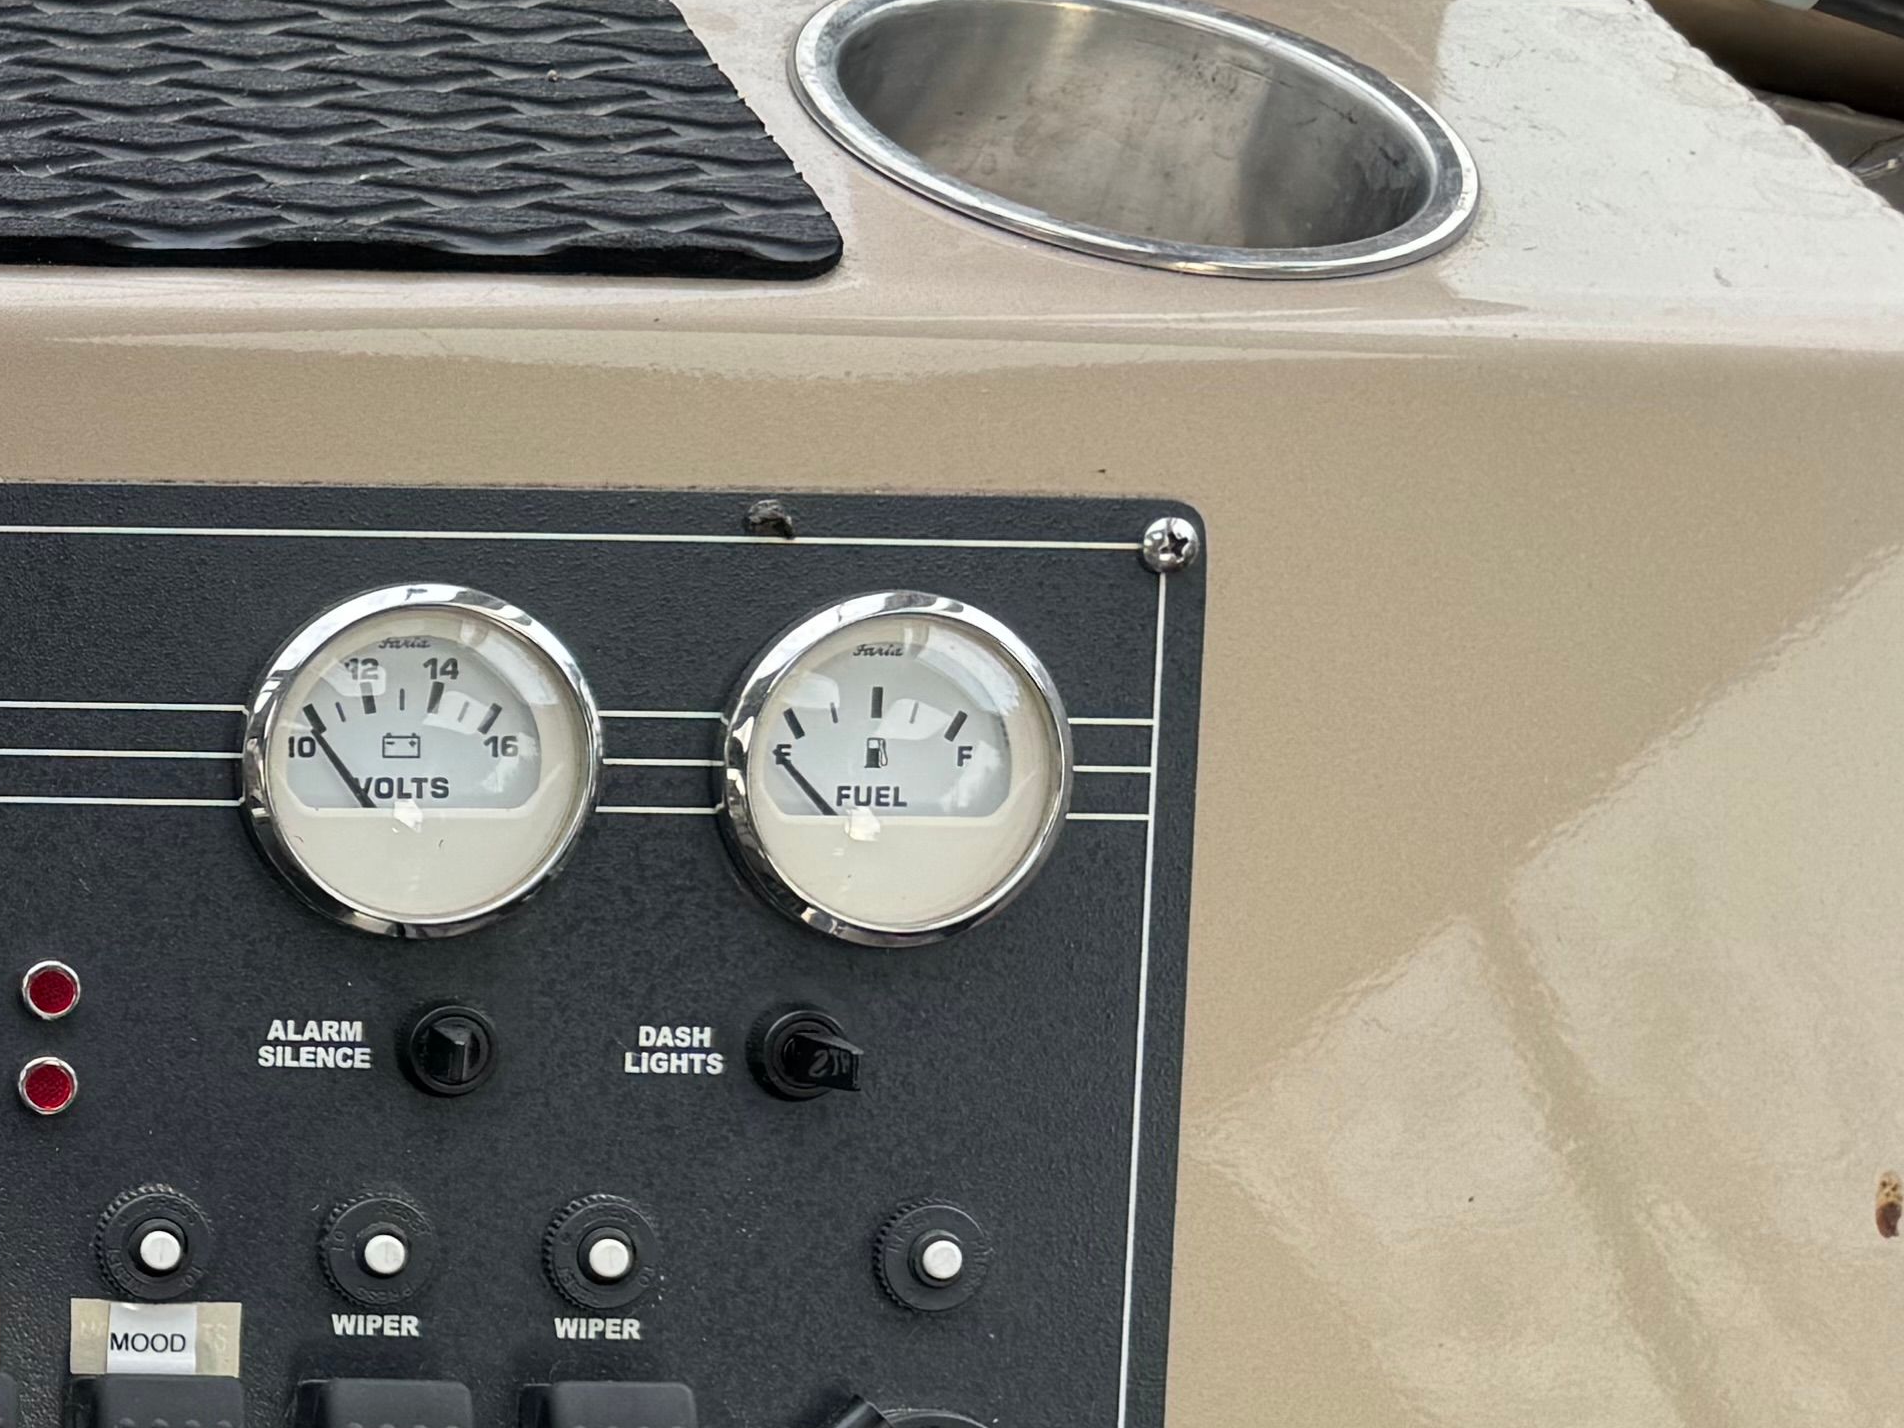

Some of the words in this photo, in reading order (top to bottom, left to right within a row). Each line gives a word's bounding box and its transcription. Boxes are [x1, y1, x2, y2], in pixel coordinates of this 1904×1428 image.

[344, 657, 380, 681] 12
[423, 657, 459, 681] 14
[288, 736, 316, 758] 10
[483, 735, 519, 758] 16
[957, 746, 973, 767] F
[354, 776, 450, 799] VOLTS
[836, 785, 908, 807] FUEL
[266, 1019, 363, 1042] ALARM
[638, 1025, 712, 1048] DASH
[257, 1046, 372, 1069] SILENCE
[624, 1051, 723, 1075] LIGHTS
[331, 1313, 420, 1337] WIPER
[554, 1317, 641, 1340] WIPER
[110, 1333, 187, 1354] MOOD
